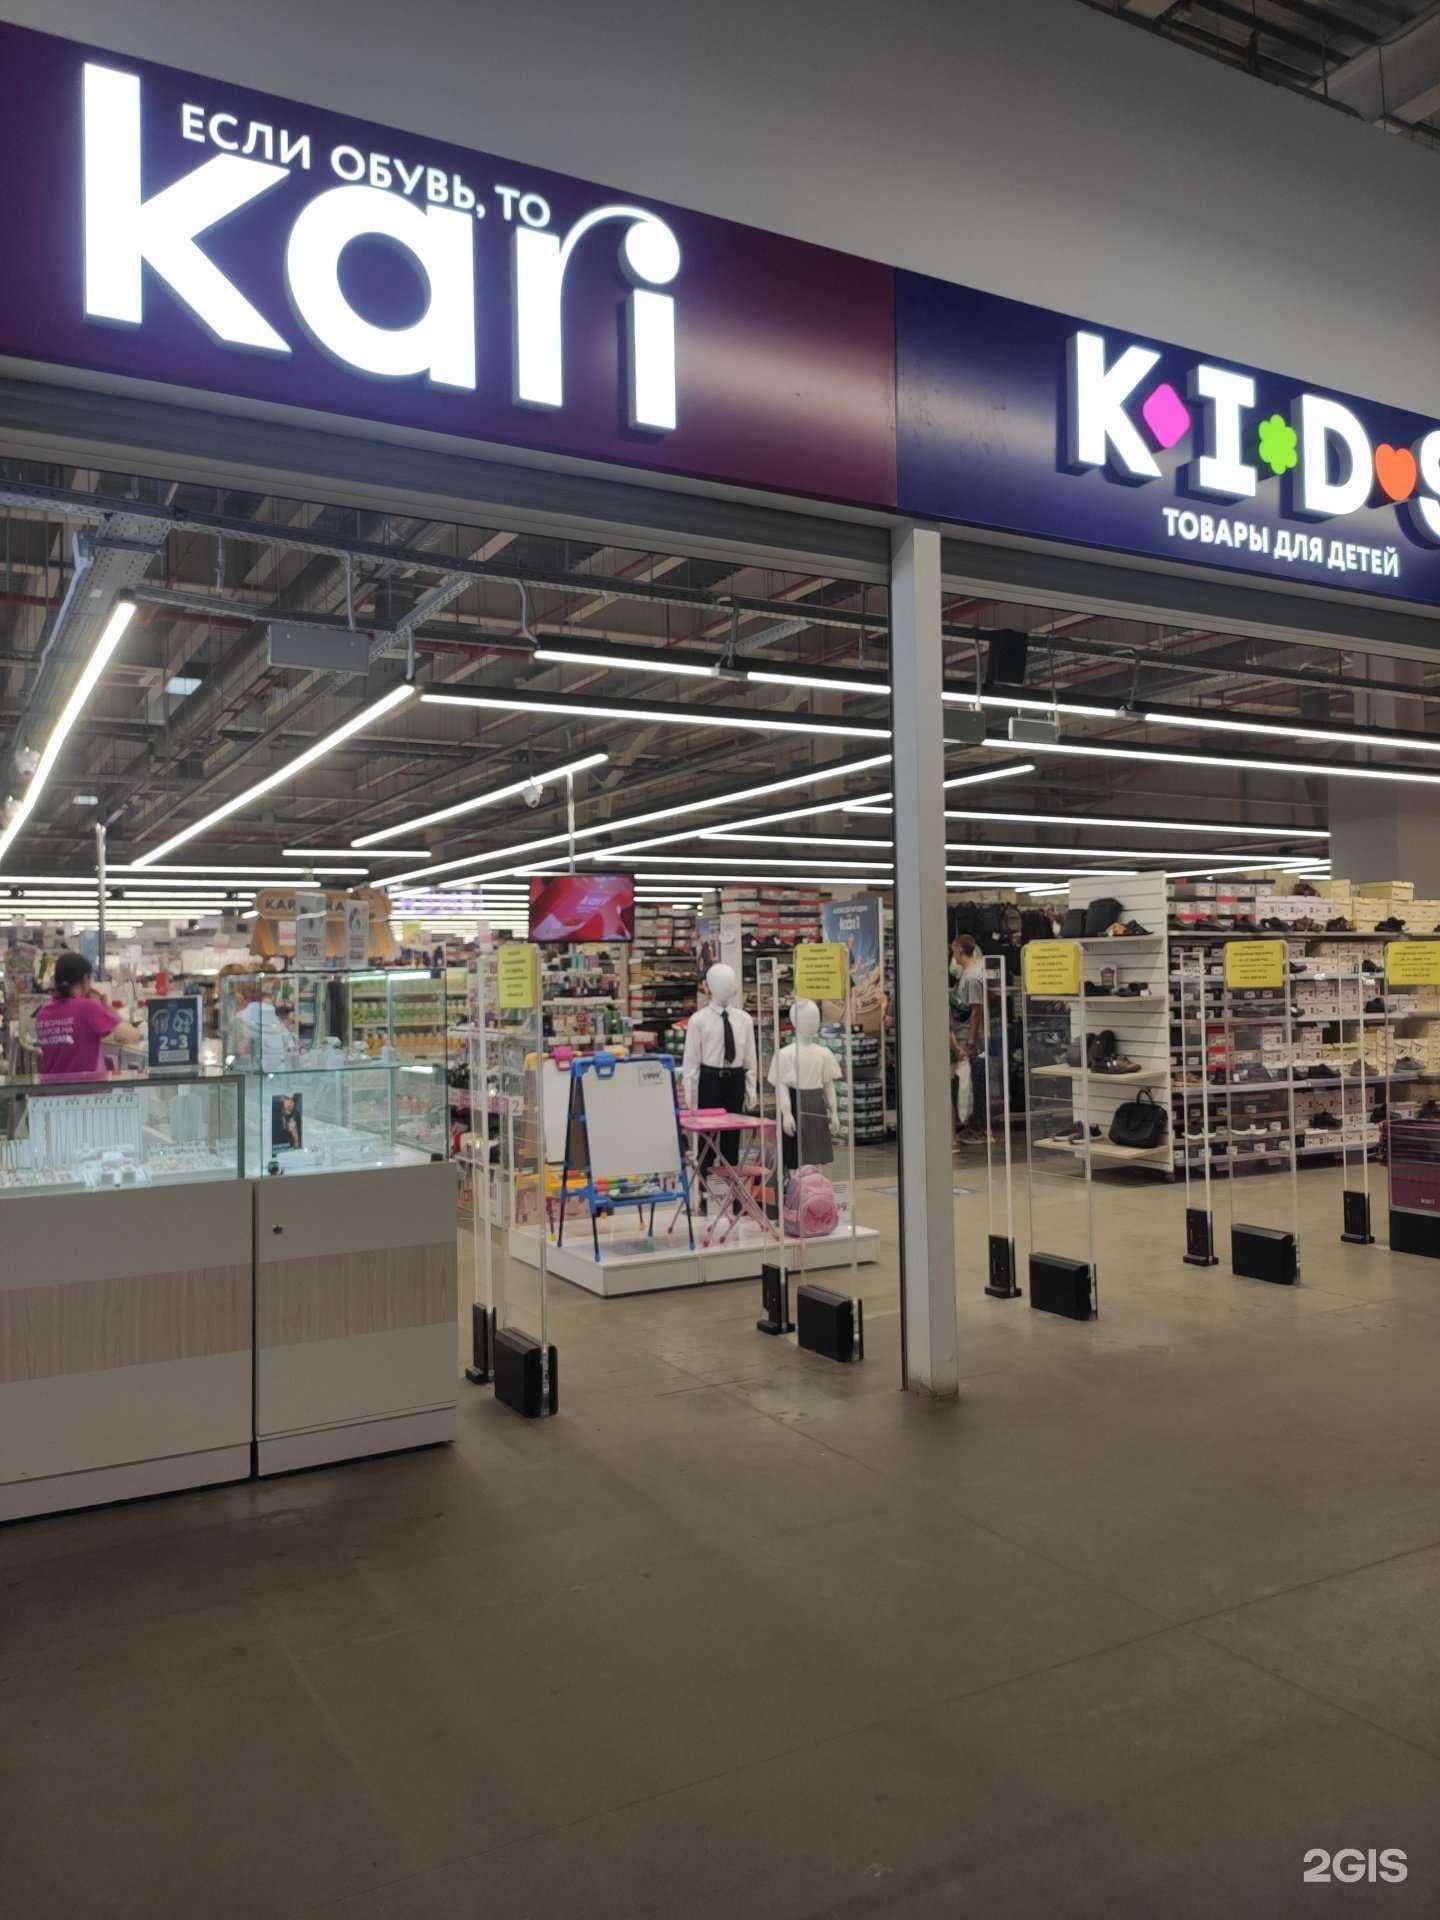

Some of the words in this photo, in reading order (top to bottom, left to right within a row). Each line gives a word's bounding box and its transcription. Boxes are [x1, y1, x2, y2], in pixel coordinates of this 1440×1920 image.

[180, 102, 311, 170] ЕСЛИ
[330, 144, 486, 219] ОБУВЬ,
[494, 185, 552, 228] ТО
[83, 62, 681, 431] kari
[1162, 507, 1269, 554] ТОВАРЫ
[1273, 530, 1324, 565] ДЛЯ
[1327, 545, 1400, 578] ДЕТЕЙ
